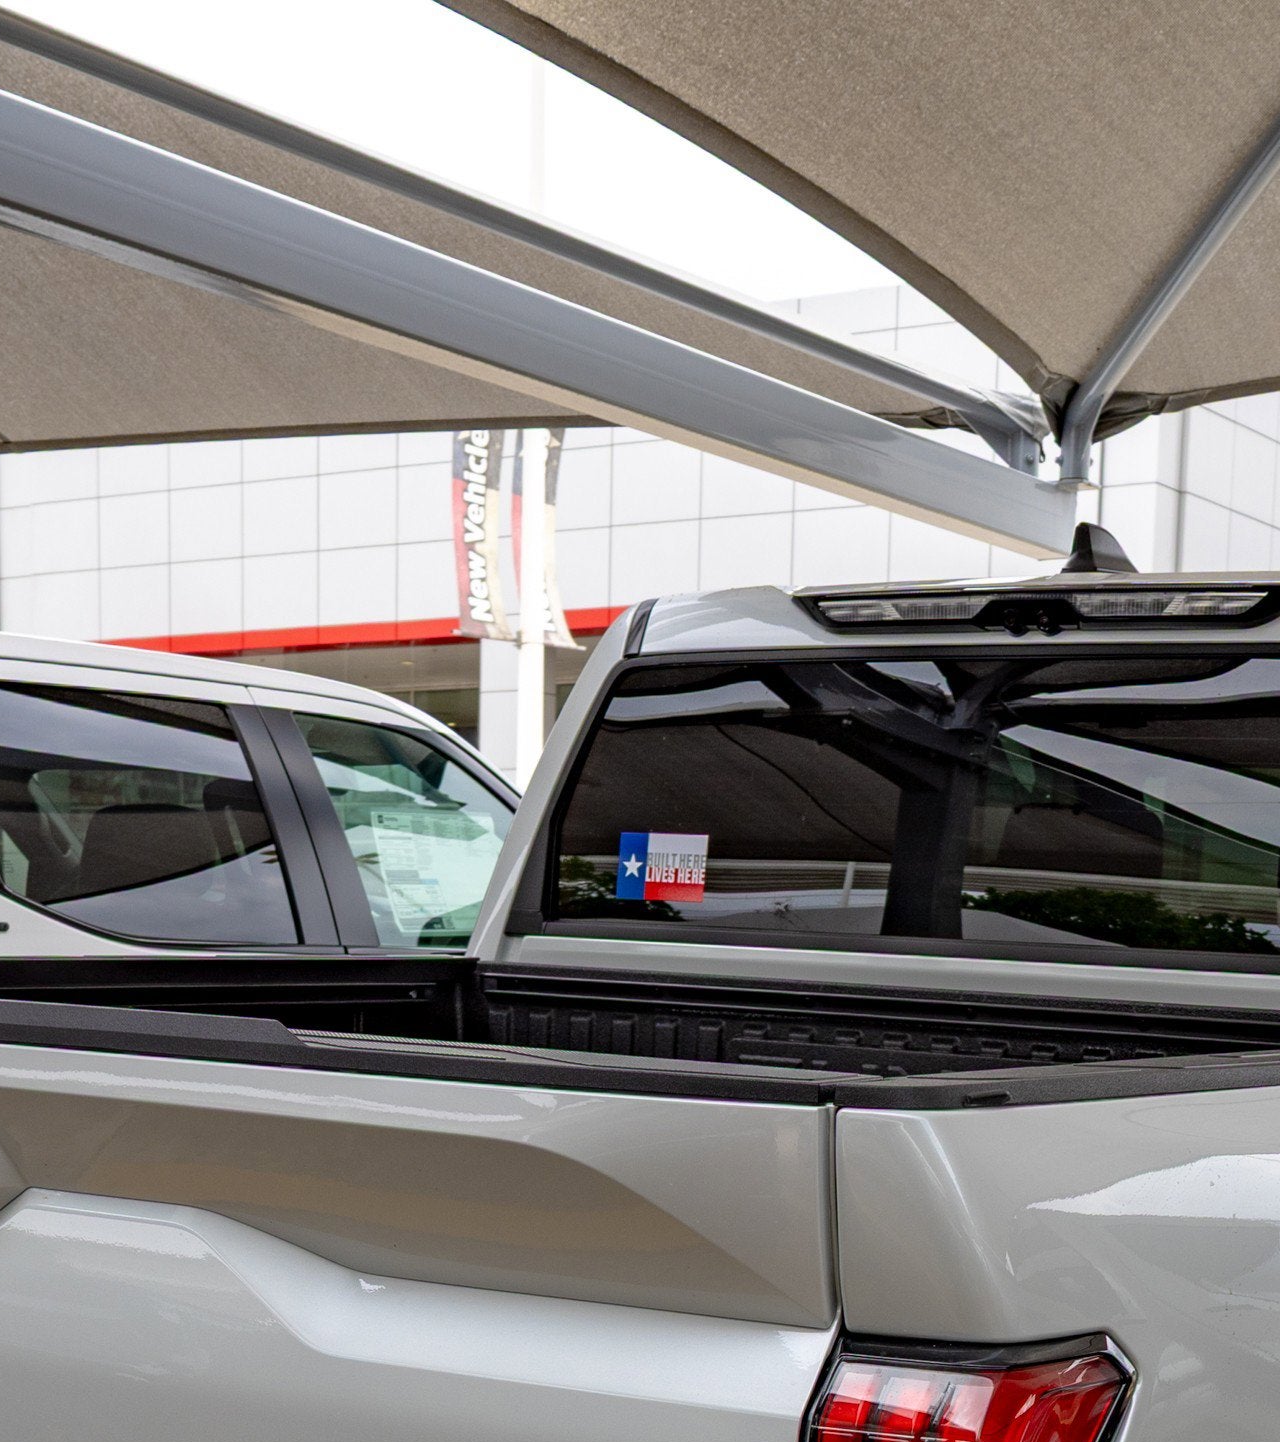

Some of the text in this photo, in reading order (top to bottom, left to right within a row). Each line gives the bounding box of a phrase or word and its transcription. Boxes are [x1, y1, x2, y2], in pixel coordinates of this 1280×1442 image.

[468, 550, 494, 623] New
[646, 852, 706, 869] BUILT HERE
[645, 866, 706, 884] LIVES HERE
